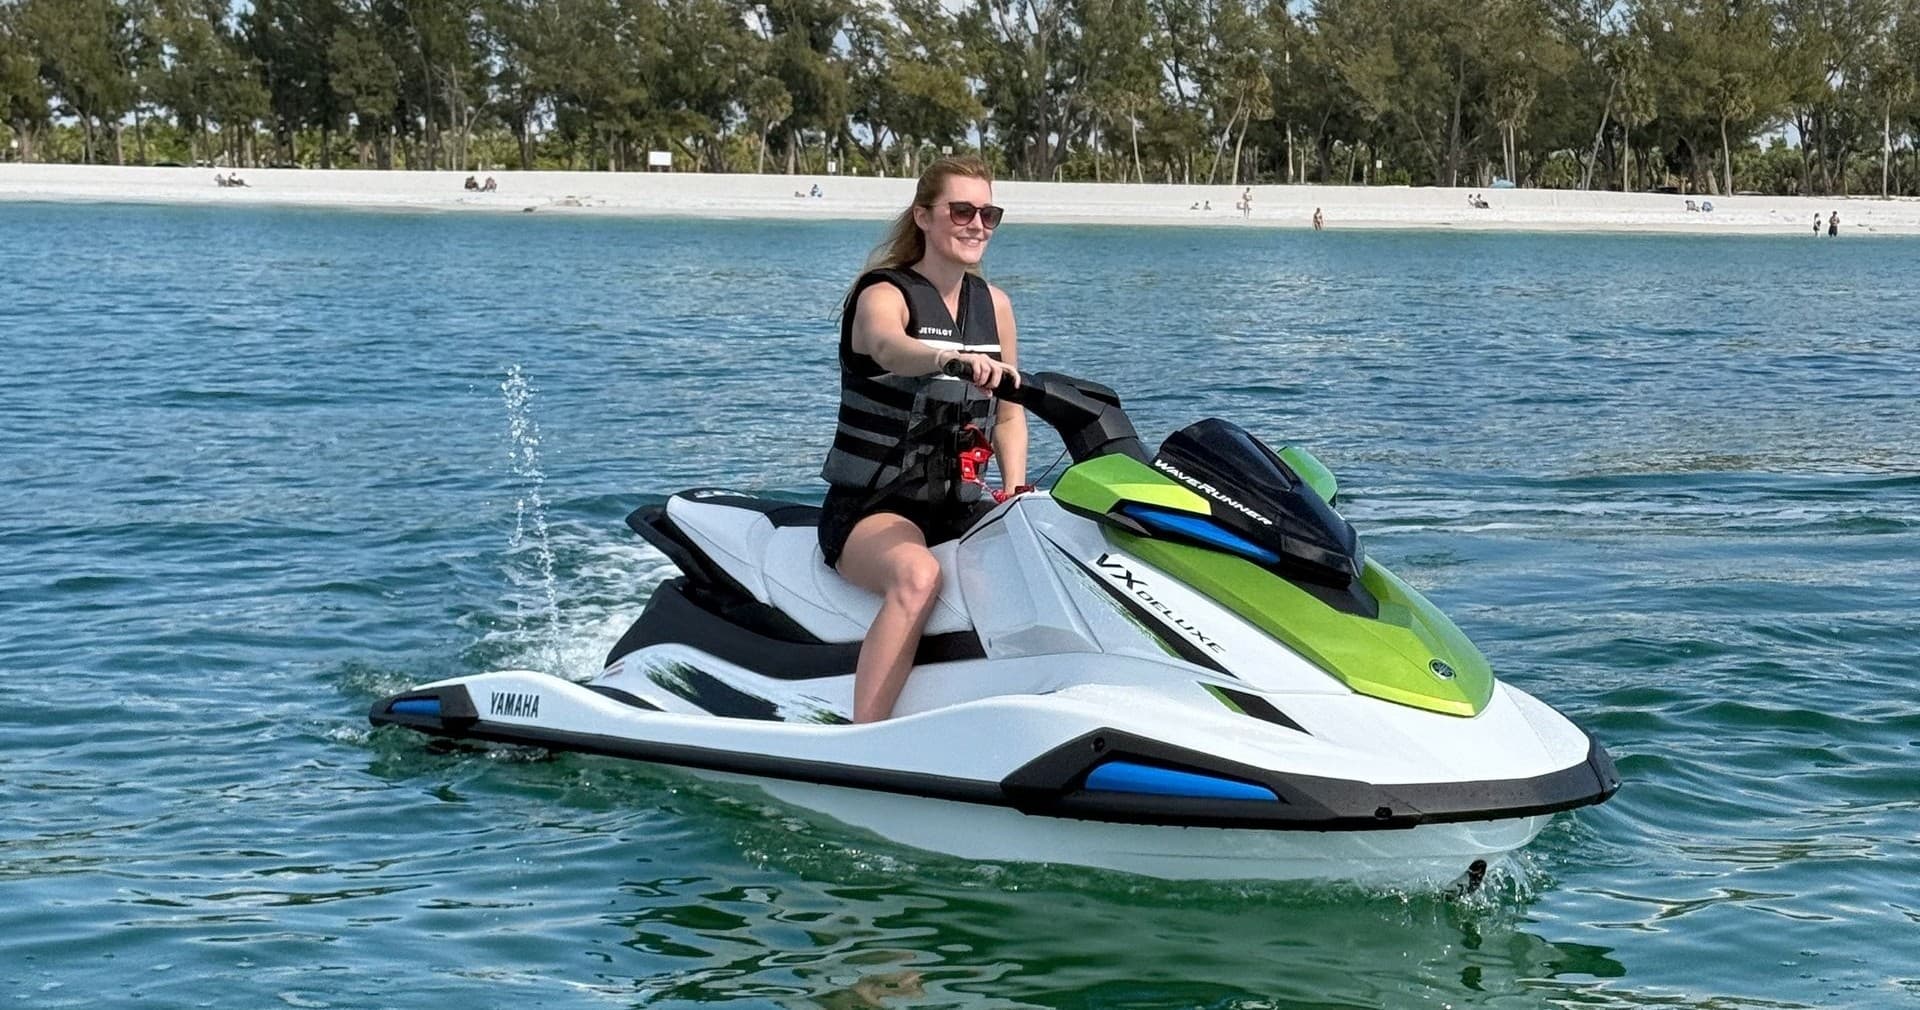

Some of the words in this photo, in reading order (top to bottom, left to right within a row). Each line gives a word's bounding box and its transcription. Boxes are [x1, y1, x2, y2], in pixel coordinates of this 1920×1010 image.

[919, 326, 953, 337] JETPILOT
[1096, 552, 1149, 591] VX
[1135, 590, 1227, 654] DELUXE
[490, 691, 540, 719] YAMAHA
